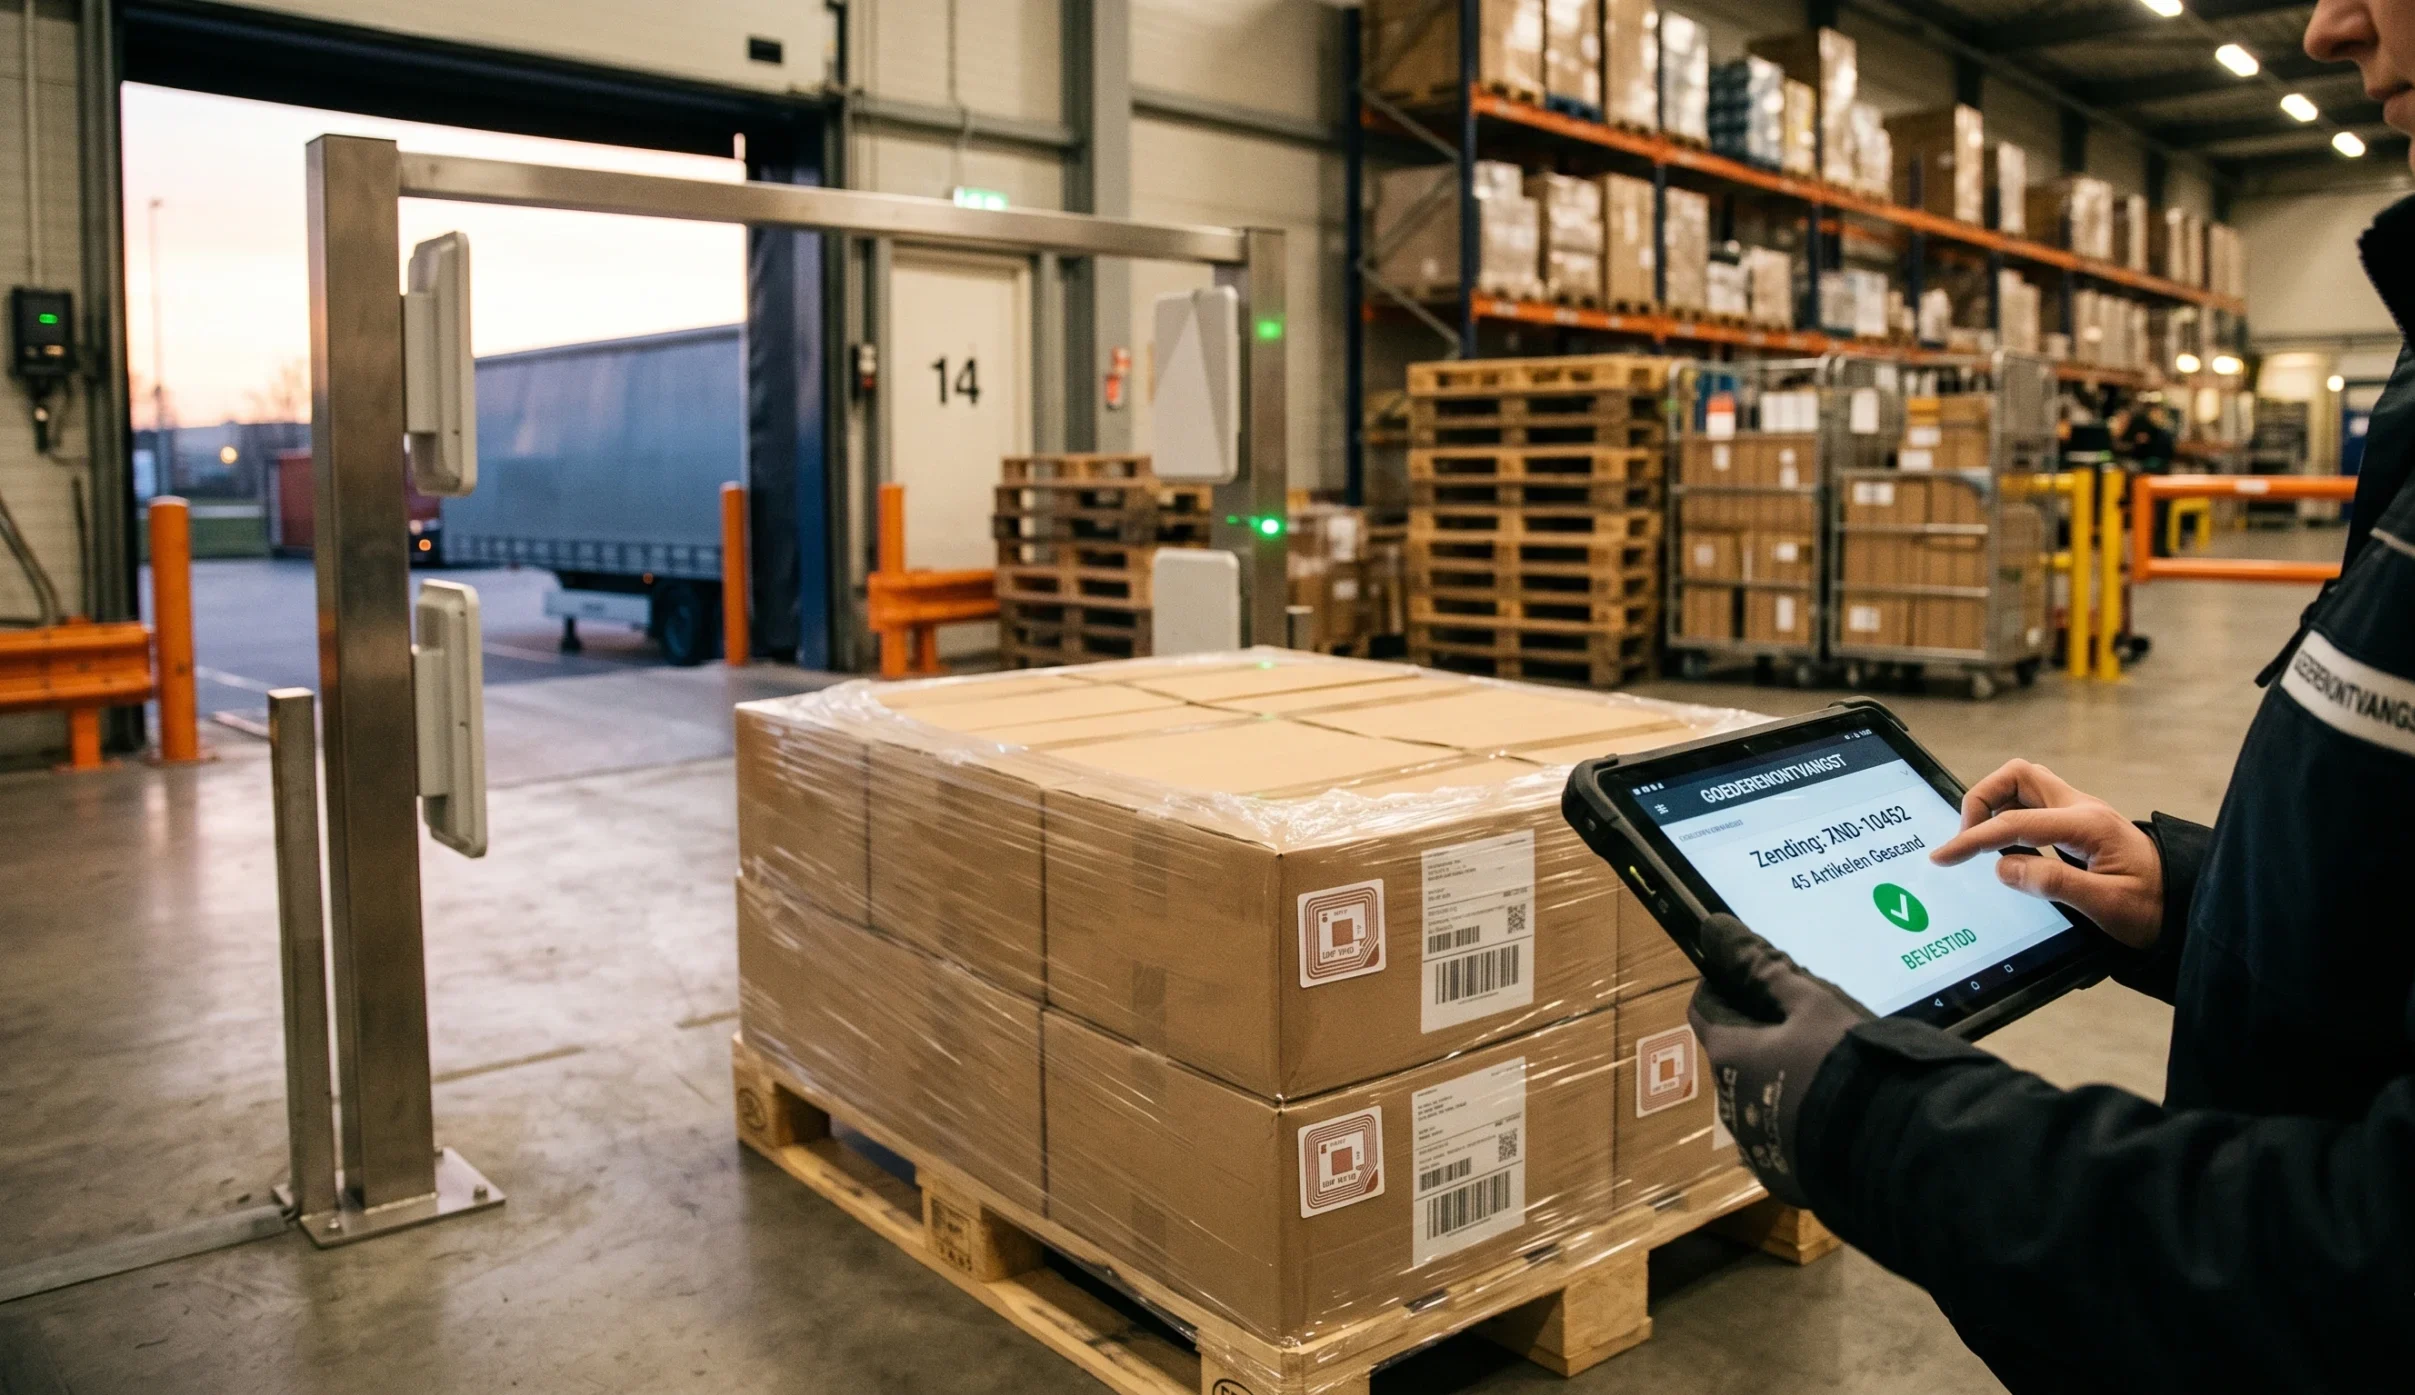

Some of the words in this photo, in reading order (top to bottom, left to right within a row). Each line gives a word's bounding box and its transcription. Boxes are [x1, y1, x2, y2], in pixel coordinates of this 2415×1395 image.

[930, 357, 980, 405] 14
[1700, 753, 1847, 804] GOEDERENONTVANGST
[1750, 834, 1827, 868] Zending:
[1791, 874, 1811, 891] 45
[1811, 857, 1873, 884] Artikelen
[1869, 834, 1925, 863] Gescand
